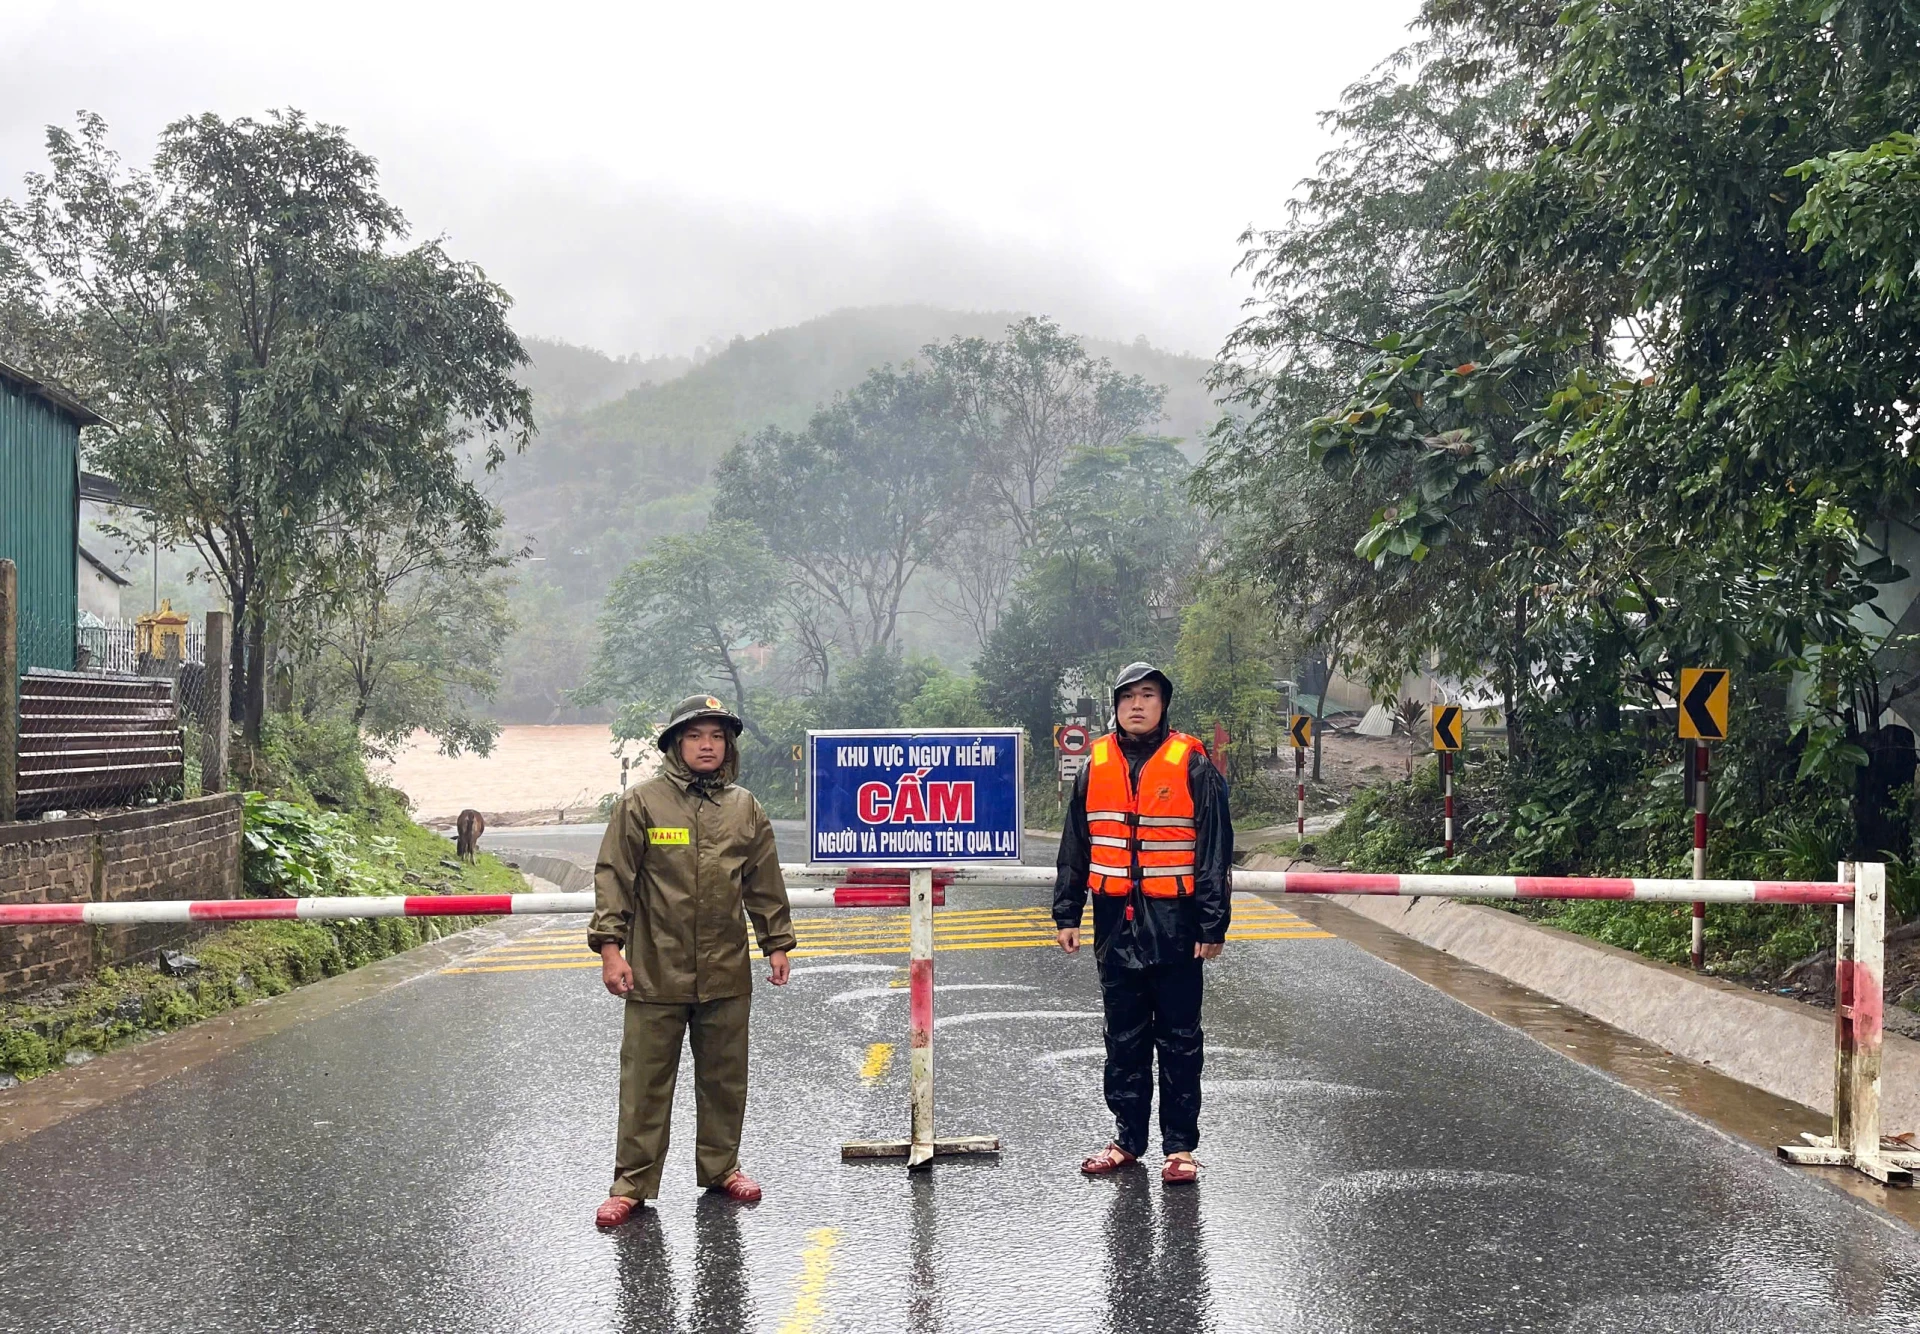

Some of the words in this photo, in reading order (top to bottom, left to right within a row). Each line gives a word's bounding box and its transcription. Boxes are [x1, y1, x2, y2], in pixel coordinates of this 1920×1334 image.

[837, 746, 869, 767] KHU
[873, 744, 904, 771] VỰC
[908, 745, 951, 767] NGUY
[955, 737, 996, 766] HIỂM
[857, 767, 975, 824] CẤM
[818, 827, 857, 853] NGƯỜI
[860, 827, 877, 853] VÀ
[880, 829, 932, 853] PHƯƠNG
[935, 827, 964, 857] TIỆN
[967, 830, 992, 854] QUA
[995, 830, 1015, 856] LẠI
